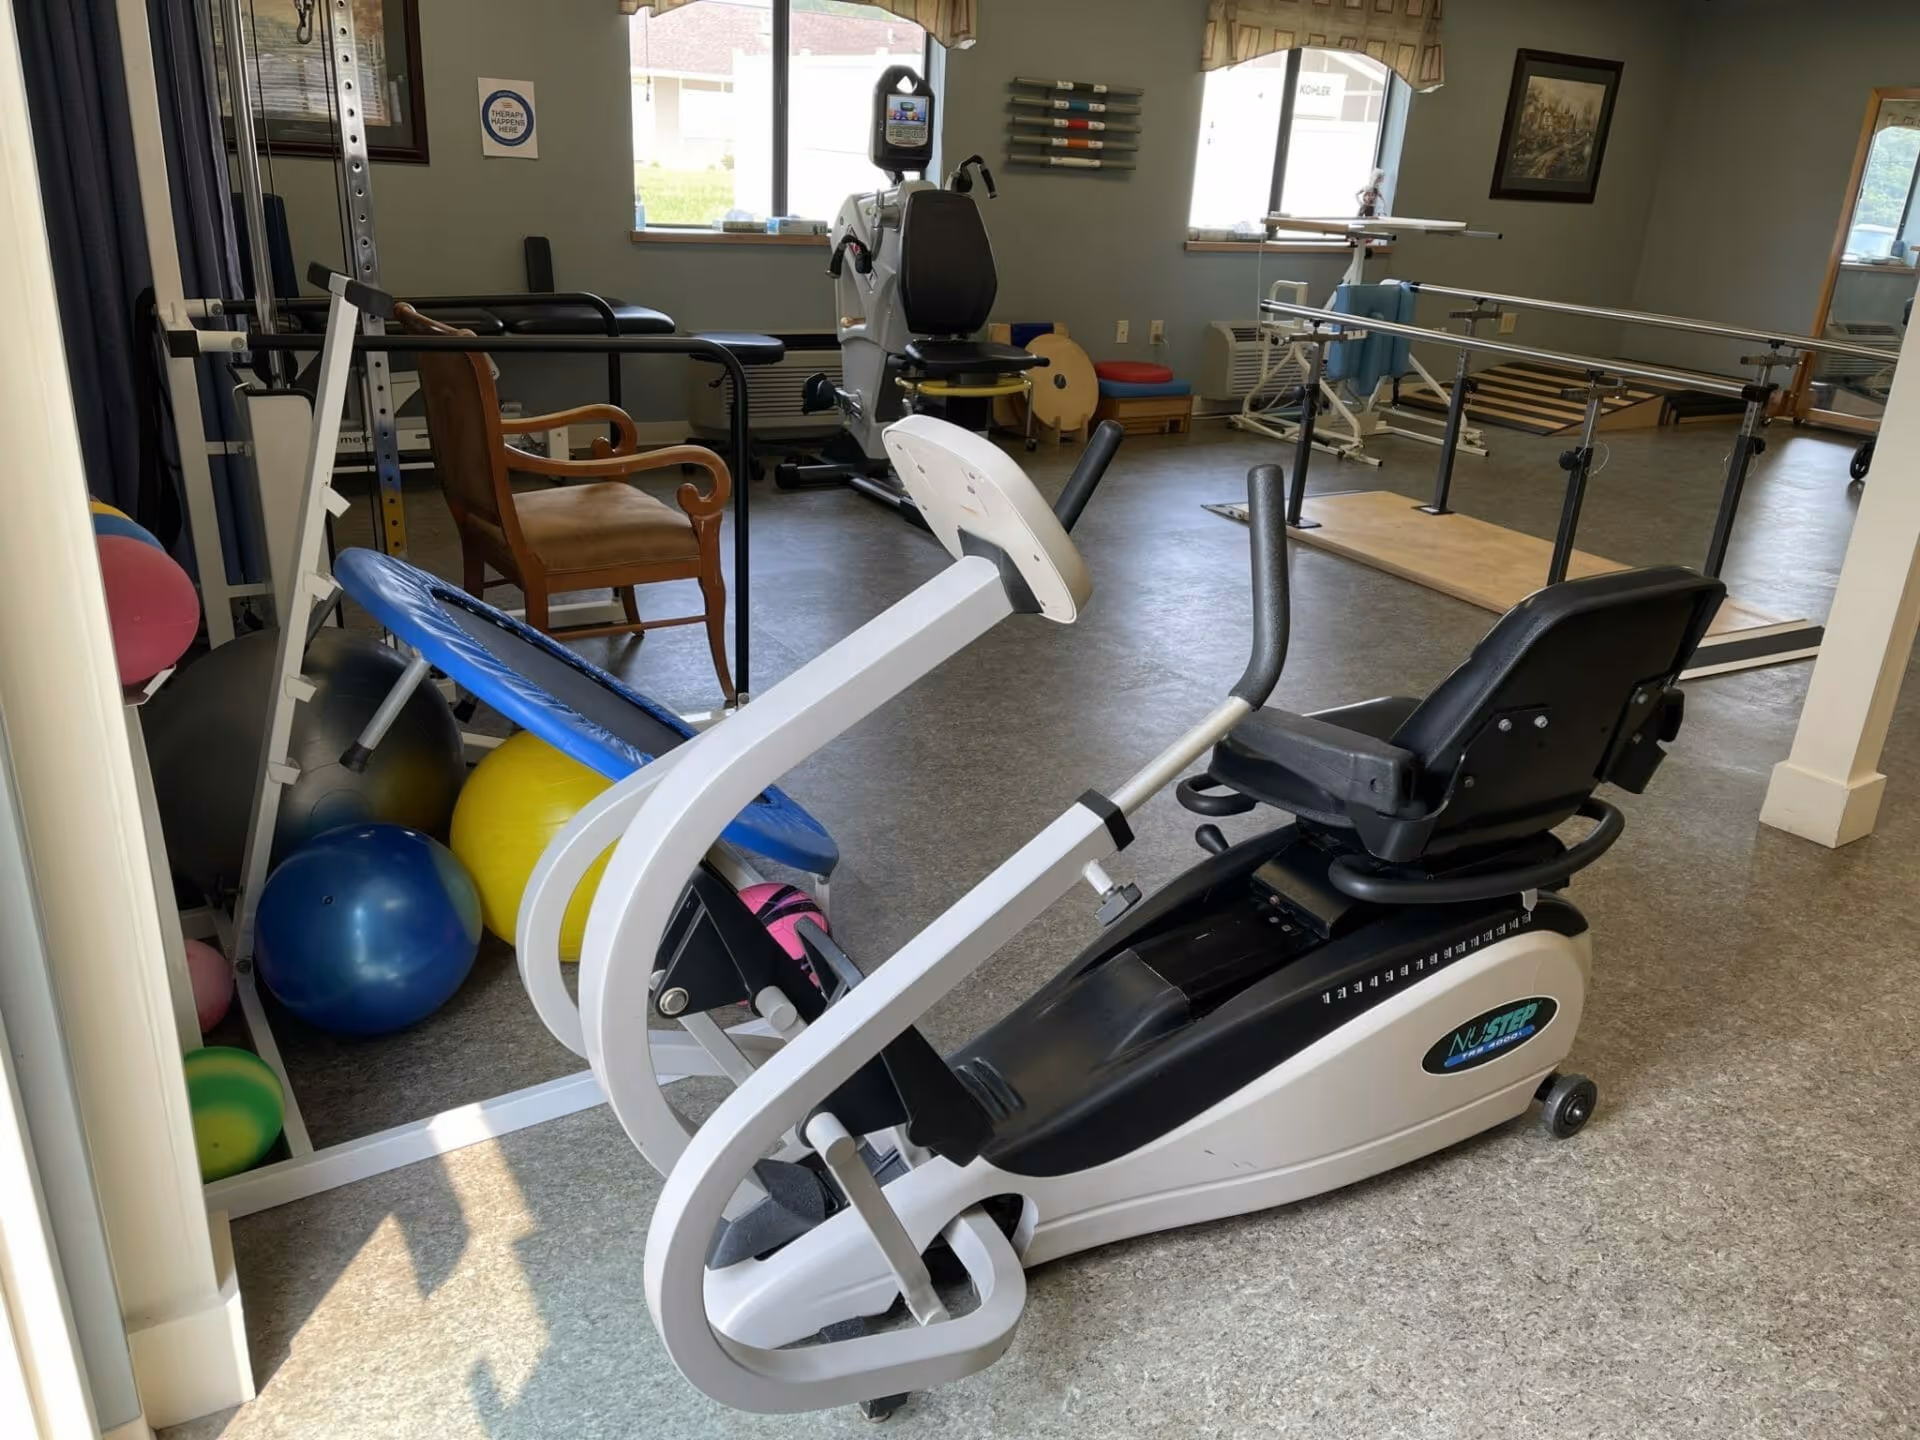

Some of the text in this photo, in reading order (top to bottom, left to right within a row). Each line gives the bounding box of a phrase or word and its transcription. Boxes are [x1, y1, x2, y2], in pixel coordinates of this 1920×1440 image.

[1300, 84, 1331, 96] KOHLER
[491, 110, 524, 119] THERAPY
[491, 118, 525, 127] HAPPENS
[499, 126, 519, 134] HERE
